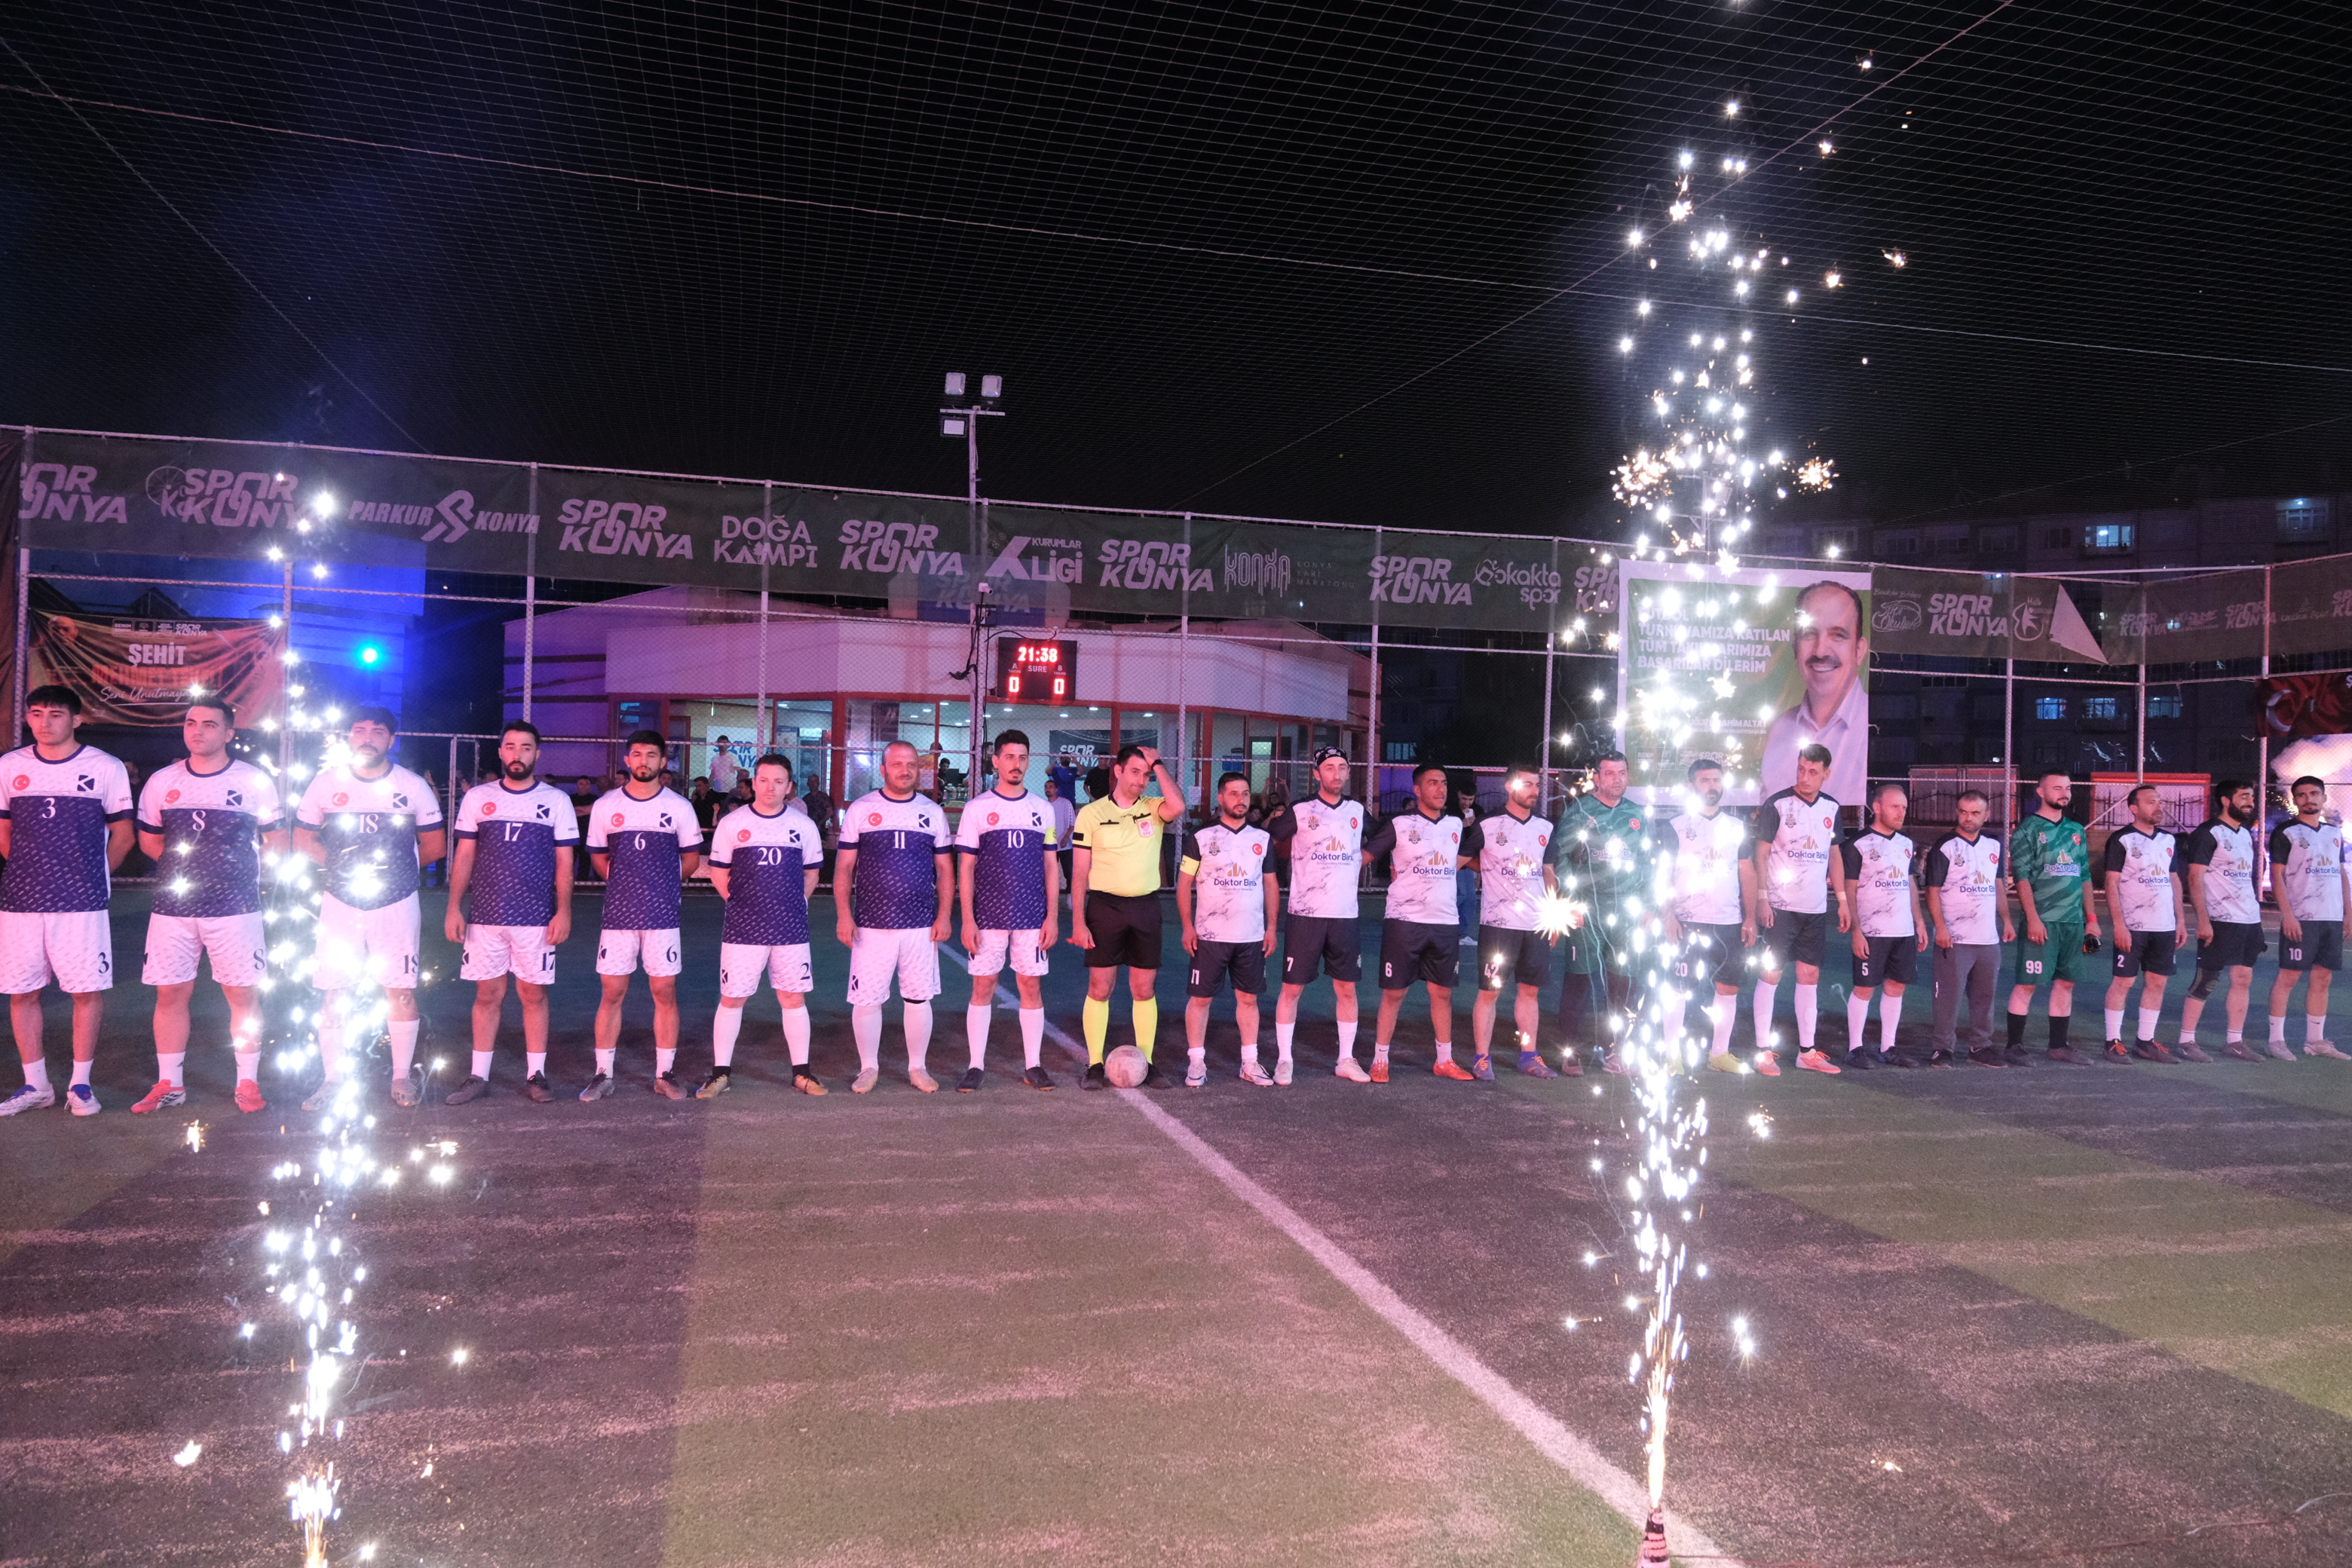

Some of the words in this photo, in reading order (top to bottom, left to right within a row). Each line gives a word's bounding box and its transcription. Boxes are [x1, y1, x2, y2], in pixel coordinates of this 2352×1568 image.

[20, 462, 97, 502] OR
[18, 481, 127, 523] ONYA
[348, 500, 434, 527] PARKUR
[474, 510, 541, 534] KONYA
[557, 498, 667, 539] SPOR
[721, 514, 811, 544] DOĞA
[838, 519, 939, 556] SPOR
[559, 519, 694, 560] KONYA
[1031, 537, 1082, 549] KURUMLAR
[839, 538, 963, 576] KONYA
[1098, 539, 1191, 575] SPOR
[1099, 556, 1214, 592] KONYA
[1367, 556, 1452, 590] SPOR
[1297, 579, 1355, 589] MARATONU
[1369, 571, 1472, 605] KONYA
[1928, 593, 1993, 615] SPOR
[176, 628, 207, 636] KONYA
[1929, 609, 2008, 638] KONYA
[128, 642, 187, 667] ŞEHİT
[1018, 646, 1058, 663] 21:38
[1638, 637, 1667, 654] TÜM
[1713, 655, 1766, 672] DİLERİM
[1009, 676, 1019, 693] 0
[1054, 678, 1064, 694] 0
[41, 798, 56, 819] 3
[191, 810, 206, 831] 8
[358, 813, 379, 834] 18
[504, 822, 523, 842] 17
[635, 832, 646, 850] 6
[894, 831, 905, 850] 11
[1007, 830, 1024, 849] 10
[757, 847, 782, 865] 20
[1413, 867, 1443, 875] Doktor
[2223, 869, 2248, 877] Doktor
[98, 951, 109, 974] 3
[253, 948, 265, 970] 8
[542, 951, 556, 971] 17
[666, 945, 678, 963] 6
[1572, 946, 1576, 961] 1
[2117, 954, 2124, 967] 2
[2289, 948, 2302, 961] 10
[403, 954, 419, 974] 18
[1287, 957, 1294, 972] 7
[1385, 962, 1392, 978] 6
[1484, 963, 1499, 978] 42
[1676, 962, 1688, 977] 20
[1861, 962, 1869, 976] 5
[2026, 960, 2042, 975] 99
